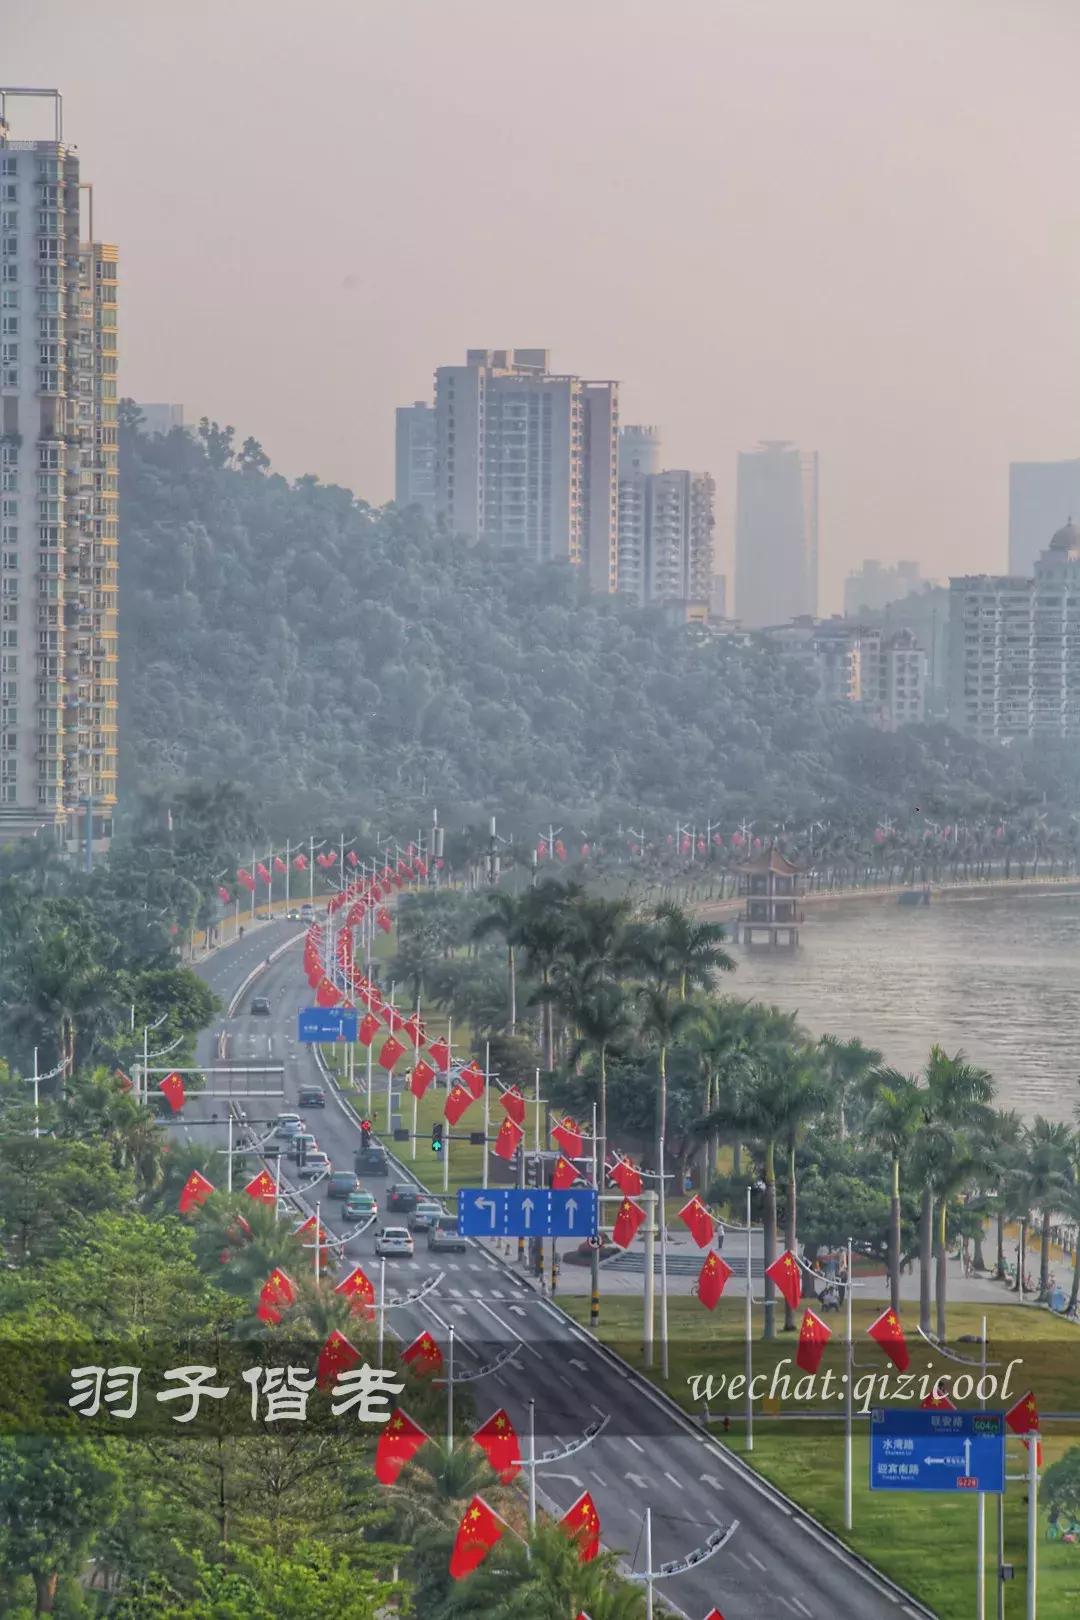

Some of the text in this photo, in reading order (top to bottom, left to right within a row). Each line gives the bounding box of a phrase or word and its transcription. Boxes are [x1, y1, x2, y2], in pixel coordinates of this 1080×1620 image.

[882, 1439, 914, 1451] 水湾路
[878, 1463, 919, 1475] 迎宾南路
